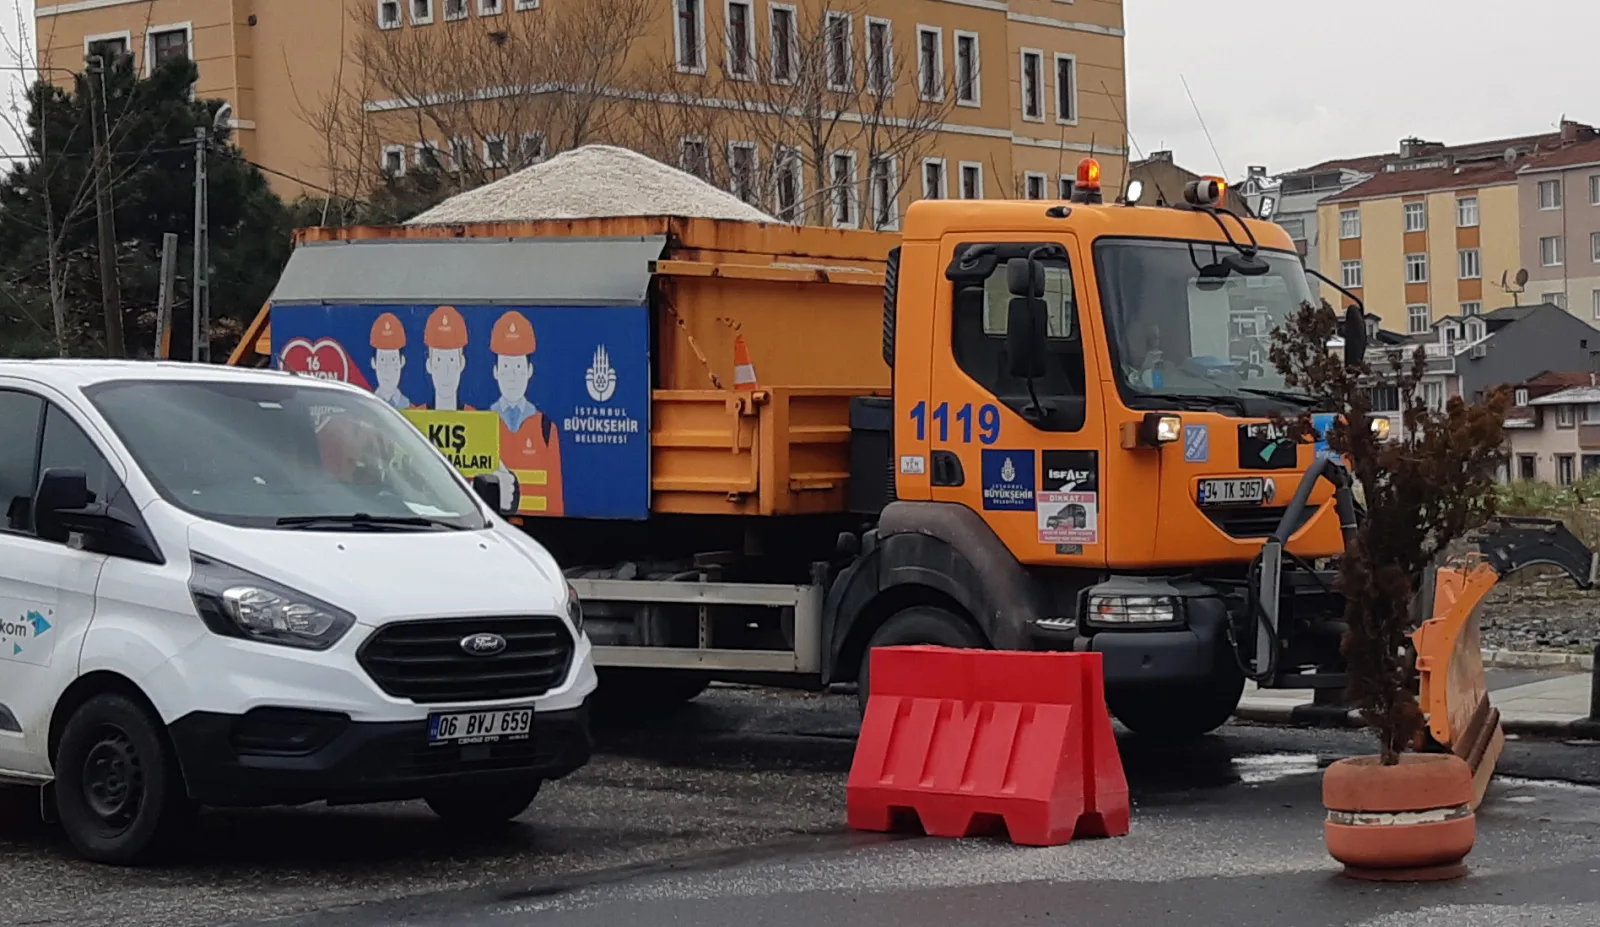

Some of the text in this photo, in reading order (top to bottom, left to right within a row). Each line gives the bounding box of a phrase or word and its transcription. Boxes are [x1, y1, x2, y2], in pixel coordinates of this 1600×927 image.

[306, 356, 320, 370] 16
[575, 405, 627, 417] İSTANBUL
[563, 416, 638, 433] BÜYÜKŞEHİR
[910, 401, 1000, 444] 1119
[428, 424, 466, 453] KIŞ
[575, 434, 627, 444] BELEDİYESİ
[1205, 480, 1261, 499] 34 TK 5057
[474, 636, 498, 649] Ford
[439, 711, 530, 736] 06 BVJ 659
